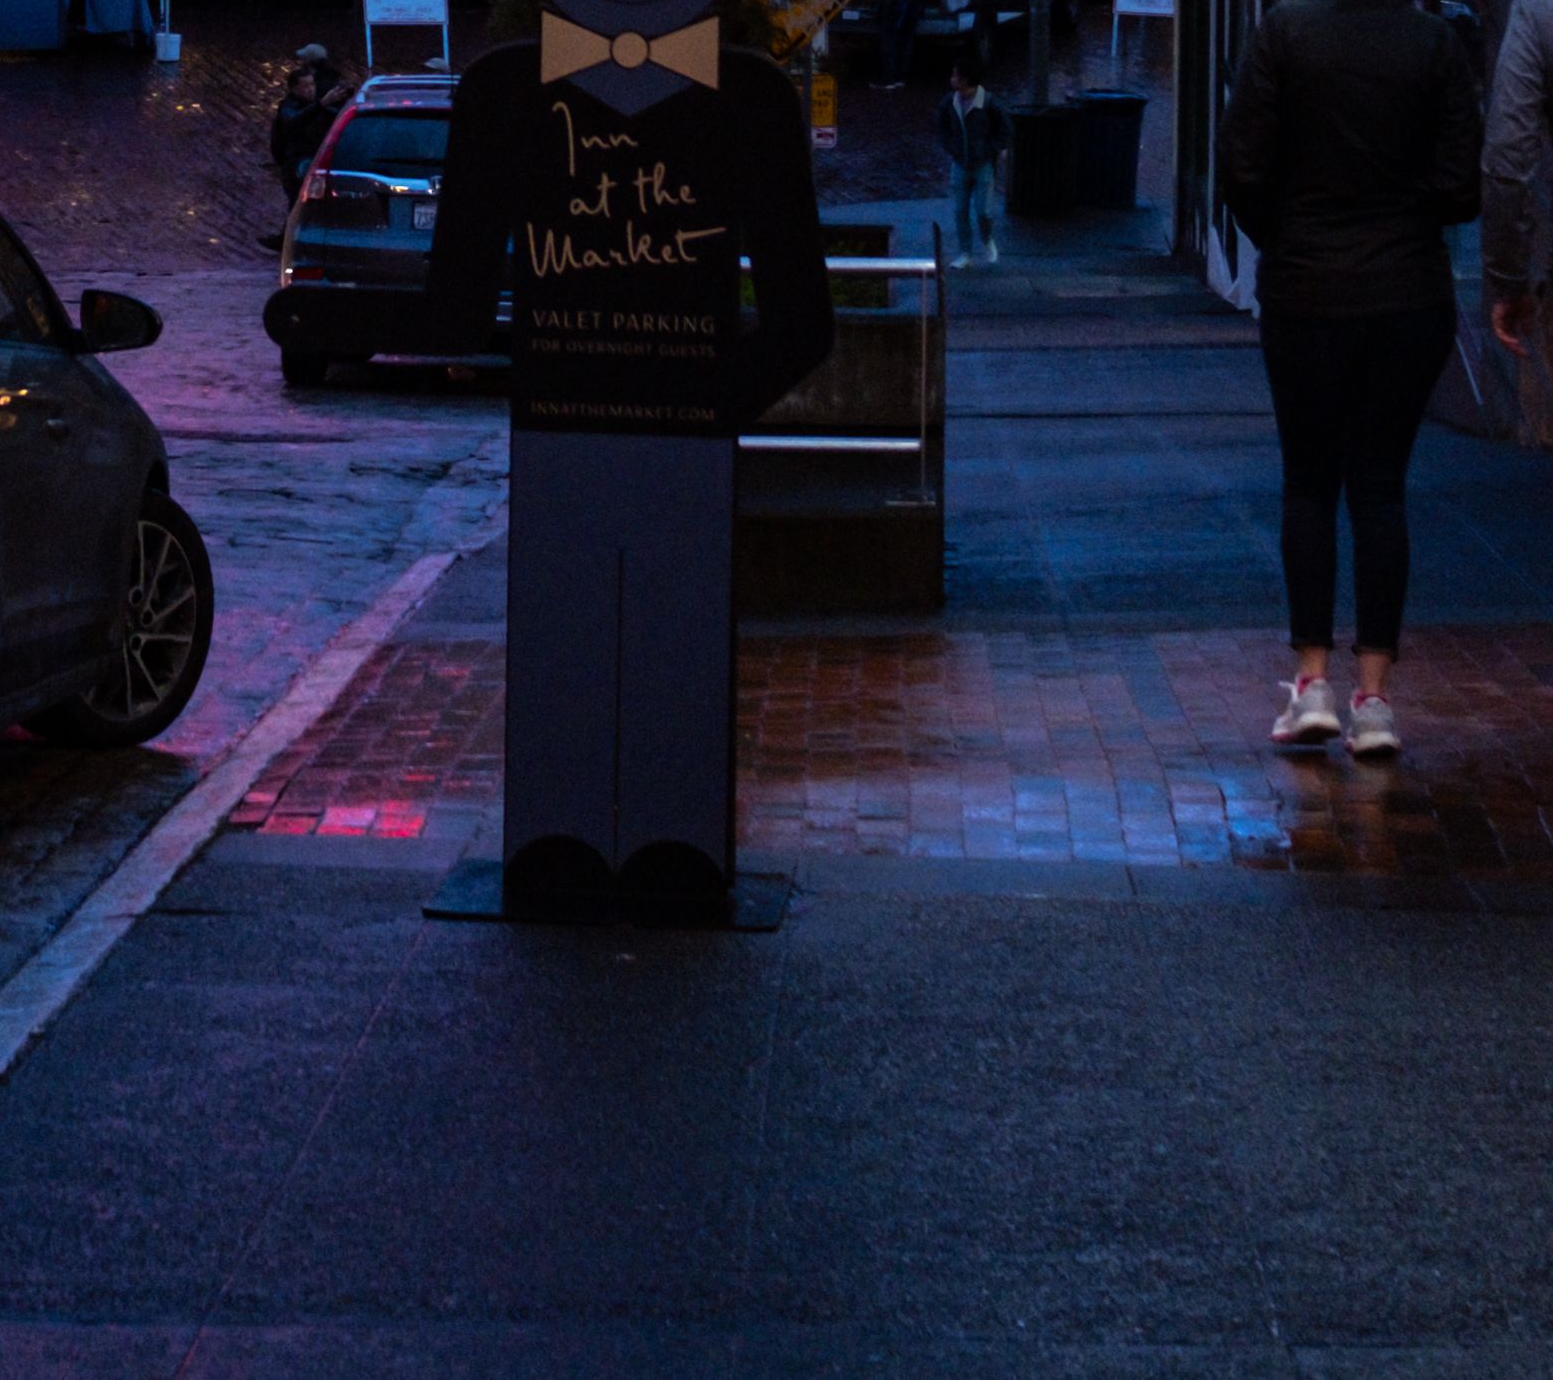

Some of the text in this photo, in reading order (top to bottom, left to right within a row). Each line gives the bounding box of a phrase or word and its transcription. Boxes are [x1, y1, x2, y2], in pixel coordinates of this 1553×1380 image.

[552, 101, 639, 177] Inn
[569, 160, 698, 219] at the
[526, 218, 728, 278] Market
[532, 309, 716, 335] VALET PARKING
[532, 338, 717, 359] FOR OVERNIGHT GUESTS
[531, 400, 717, 422] INNATTHEMARKET.COM
